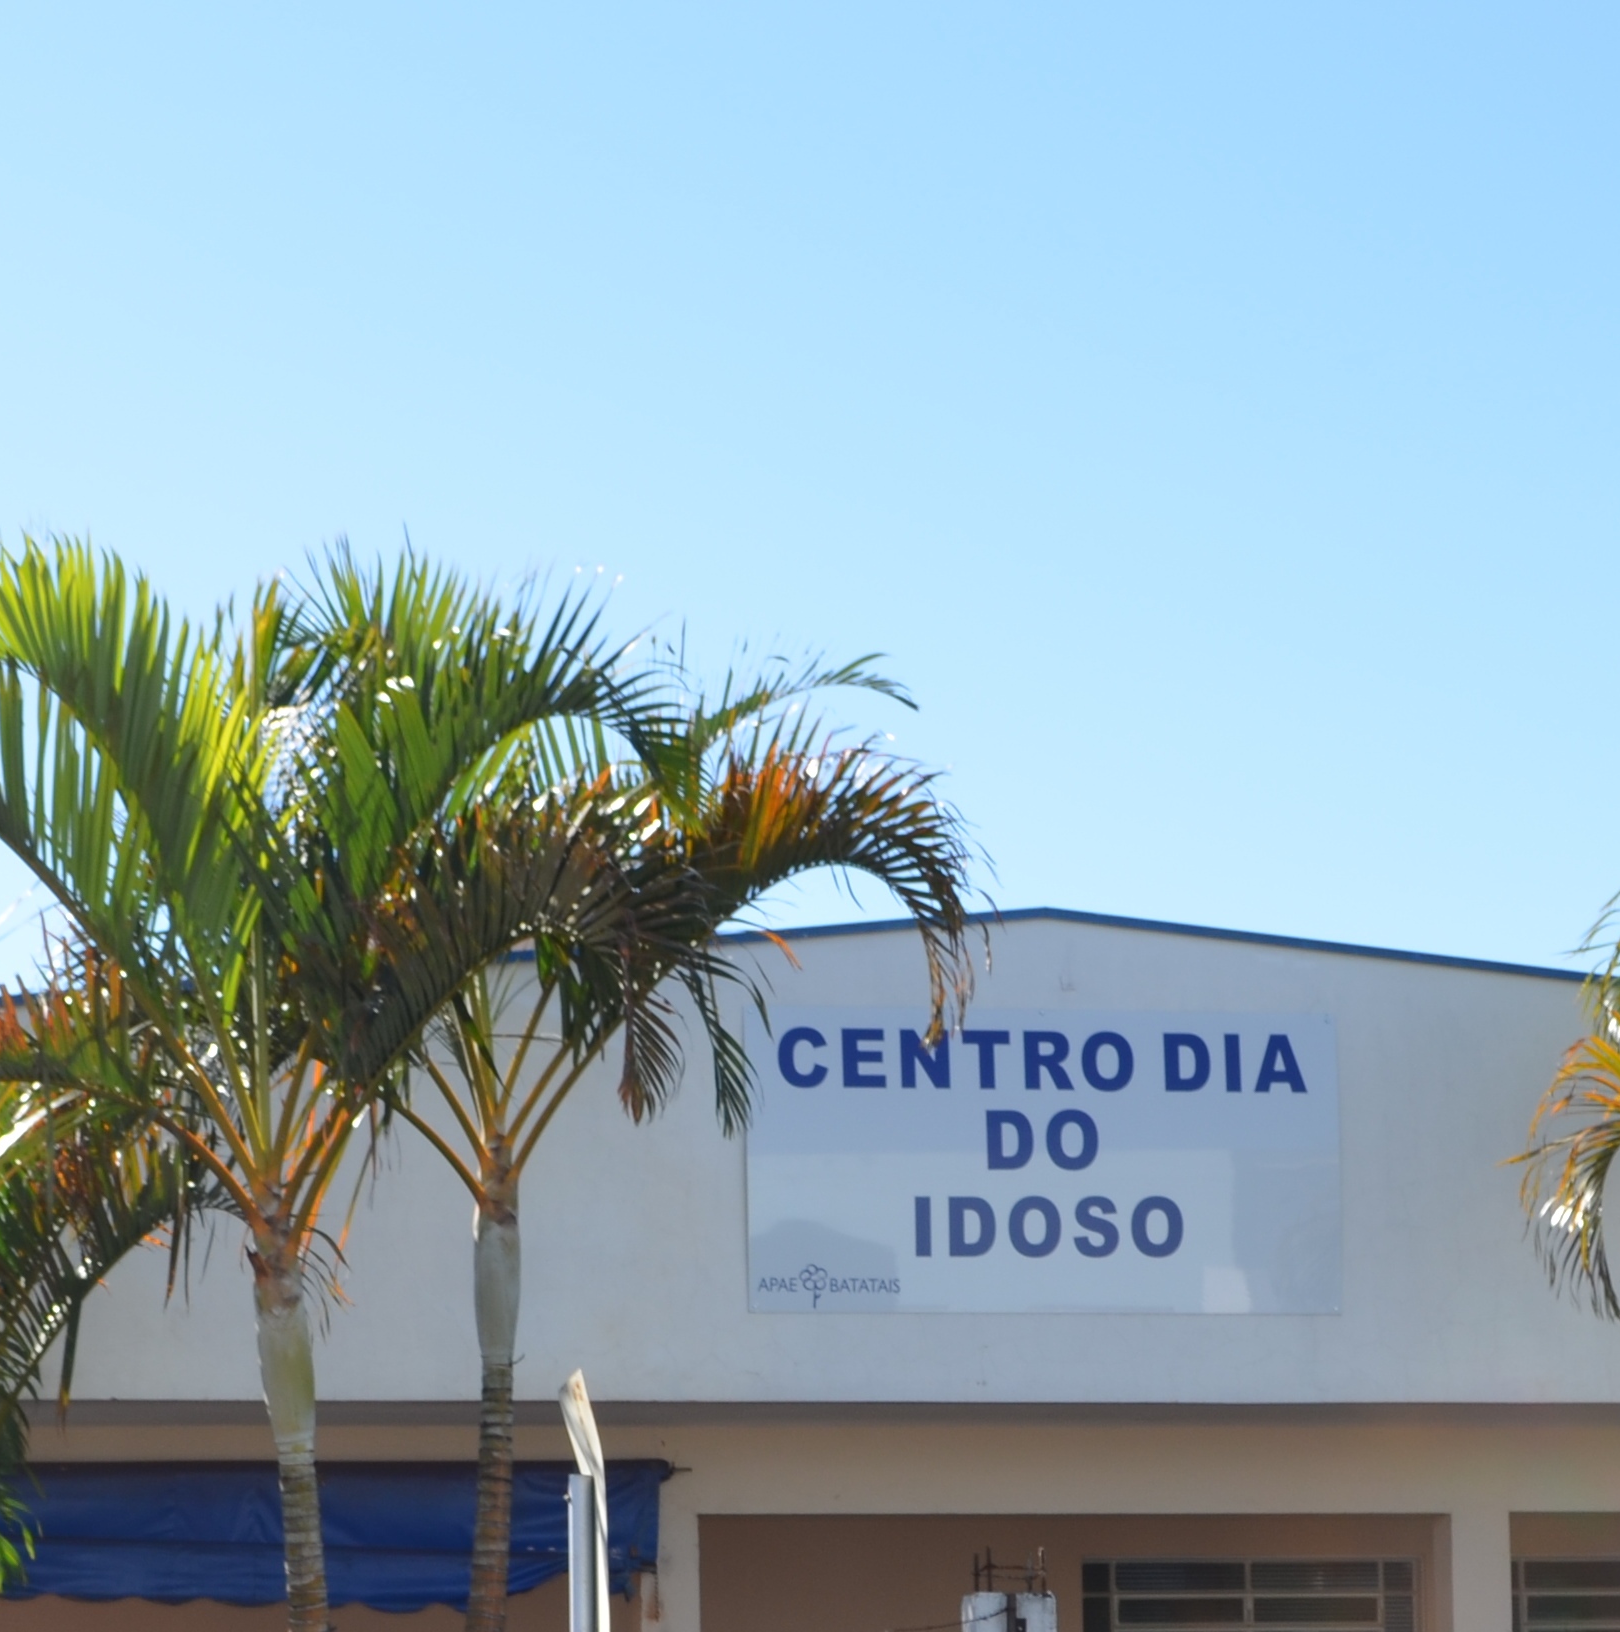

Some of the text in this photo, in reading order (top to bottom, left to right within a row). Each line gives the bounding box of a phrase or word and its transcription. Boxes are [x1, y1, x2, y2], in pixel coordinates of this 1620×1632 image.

[778, 1026, 1308, 1093] CENTRO DIA
[985, 1109, 1099, 1171] DO
[914, 1196, 1184, 1258] IDOSO
[757, 1277, 901, 1294] APAE BATATAIS
